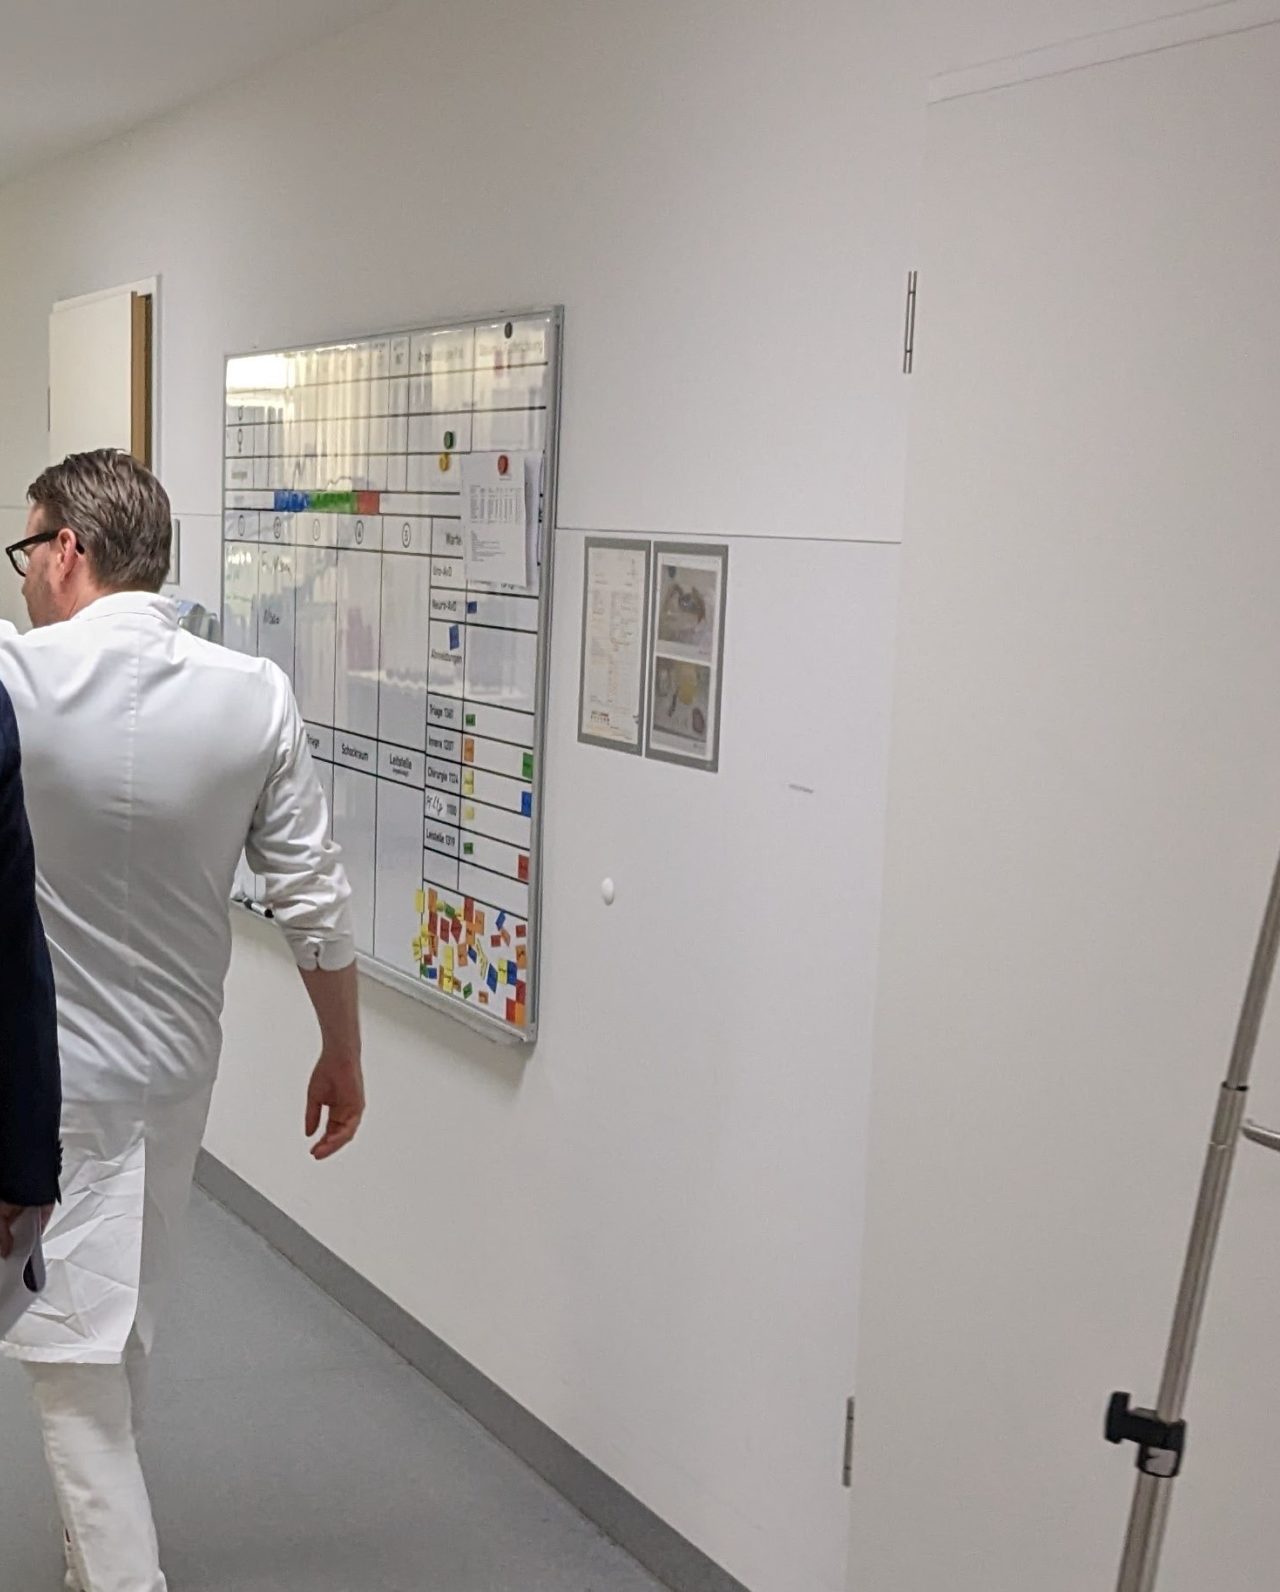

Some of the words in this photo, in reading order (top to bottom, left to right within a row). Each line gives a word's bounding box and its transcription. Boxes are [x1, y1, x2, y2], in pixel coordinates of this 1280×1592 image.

[429, 703, 442, 719] Triage
[429, 735, 442, 749] Innere
[341, 743, 369, 761] Schockraum
[389, 753, 412, 770] Leitstelle
[427, 766, 448, 783] Chirurgie
